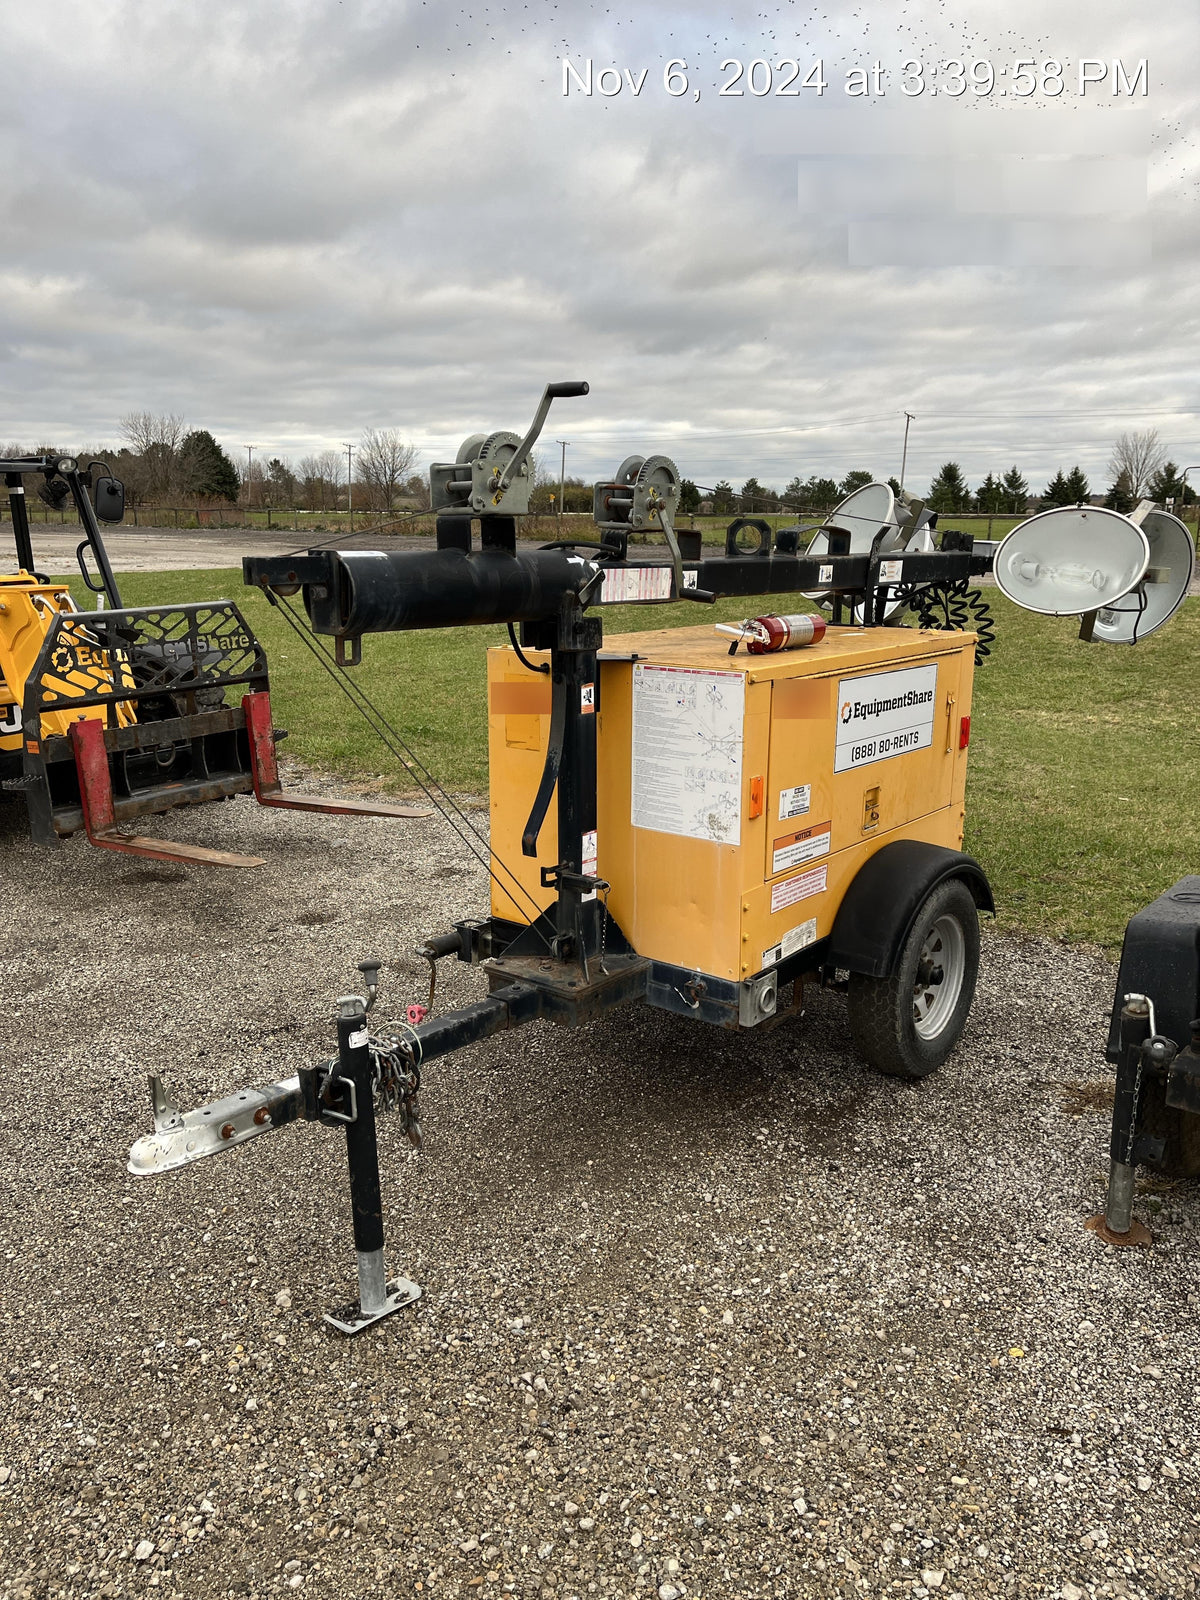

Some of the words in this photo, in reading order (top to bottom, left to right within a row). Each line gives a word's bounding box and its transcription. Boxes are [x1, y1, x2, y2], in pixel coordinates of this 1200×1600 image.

[853, 690, 933, 720] EquipmentShare
[851, 741, 877, 762] (888)
[879, 731, 919, 754] 80-RENTS
[794, 830, 813, 841] NOTICE
